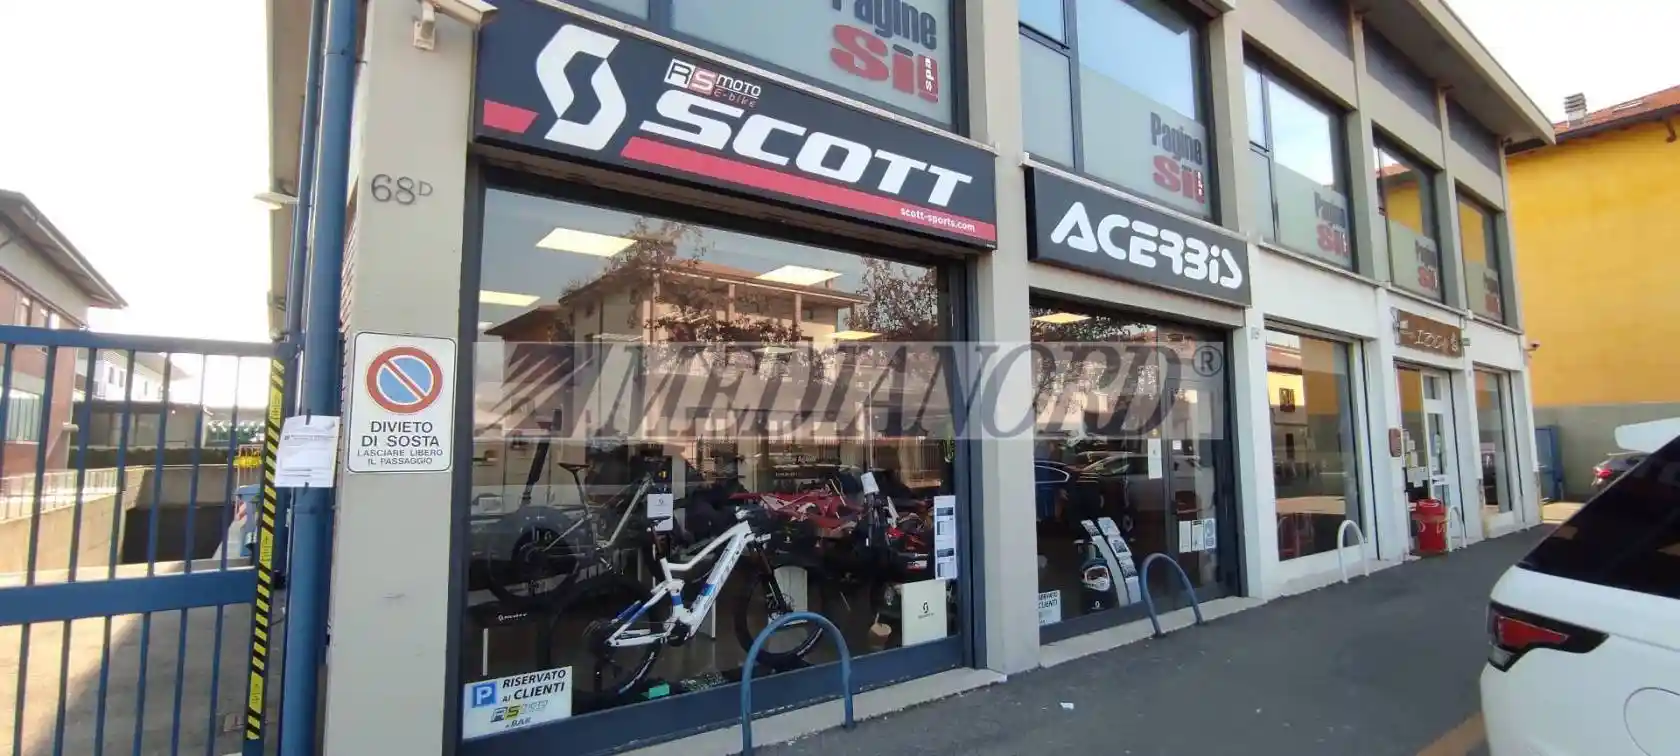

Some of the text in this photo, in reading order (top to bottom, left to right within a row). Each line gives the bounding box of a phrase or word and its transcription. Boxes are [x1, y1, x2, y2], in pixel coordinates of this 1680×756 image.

[832, 0, 937, 50] agine
[664, 59, 719, 97] RS
[924, 56, 935, 92] spa
[639, 89, 973, 207] SCOTT
[899, 206, 976, 233] scott-sports.com
[370, 420, 433, 433] DIVIETO
[361, 435, 440, 447] DI SOSTA
[357, 448, 444, 457] LASCIARE LIBERO
[367, 457, 433, 466] IL PASSAGGIO
[502, 669, 567, 688] RISERVATO
[476, 686, 492, 705] P
[513, 682, 565, 700] CLIENTI
